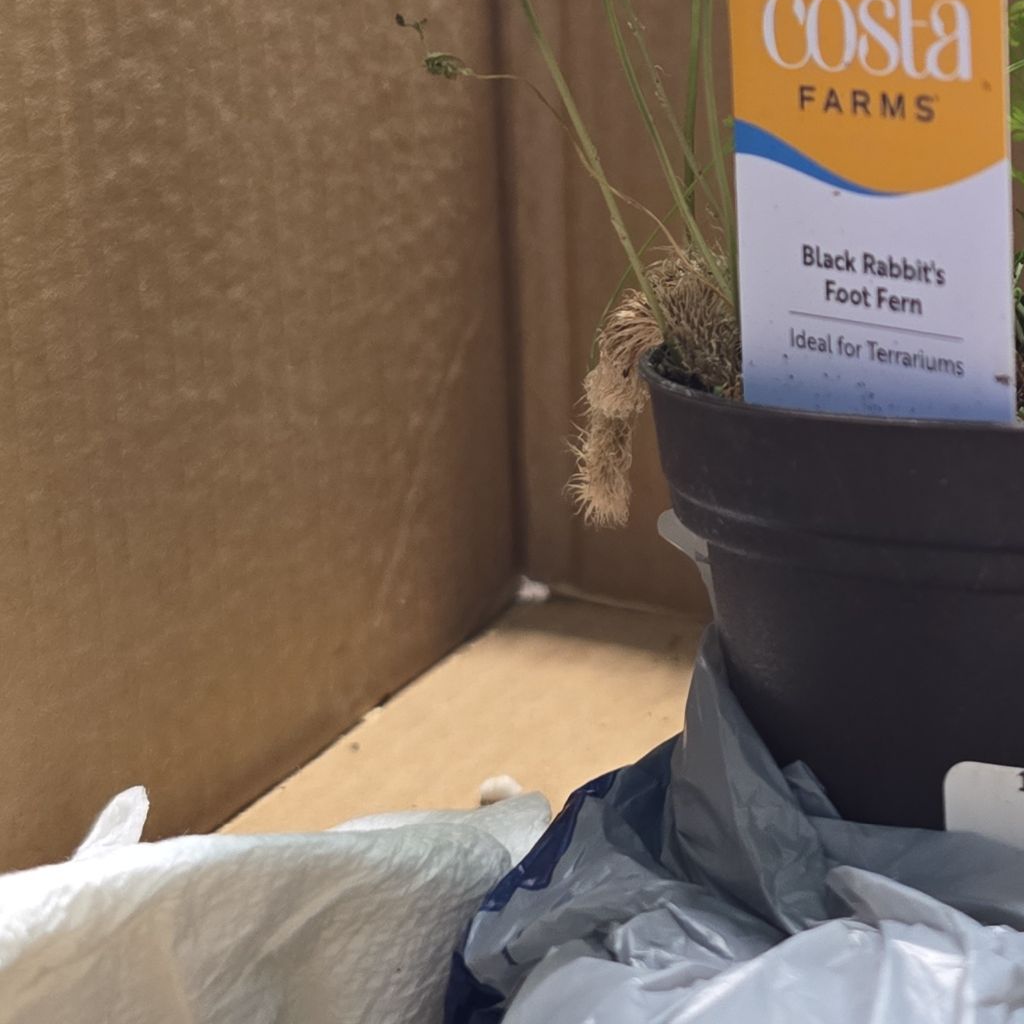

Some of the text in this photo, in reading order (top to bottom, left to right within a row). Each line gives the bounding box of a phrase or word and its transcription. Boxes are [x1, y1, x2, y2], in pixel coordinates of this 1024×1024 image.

[798, 85, 936, 124] FARMS
[802, 244, 946, 286] Black Rabbit's
[825, 280, 923, 315] Foot Fern
[789, 327, 965, 377] Ideal for Terrariums
